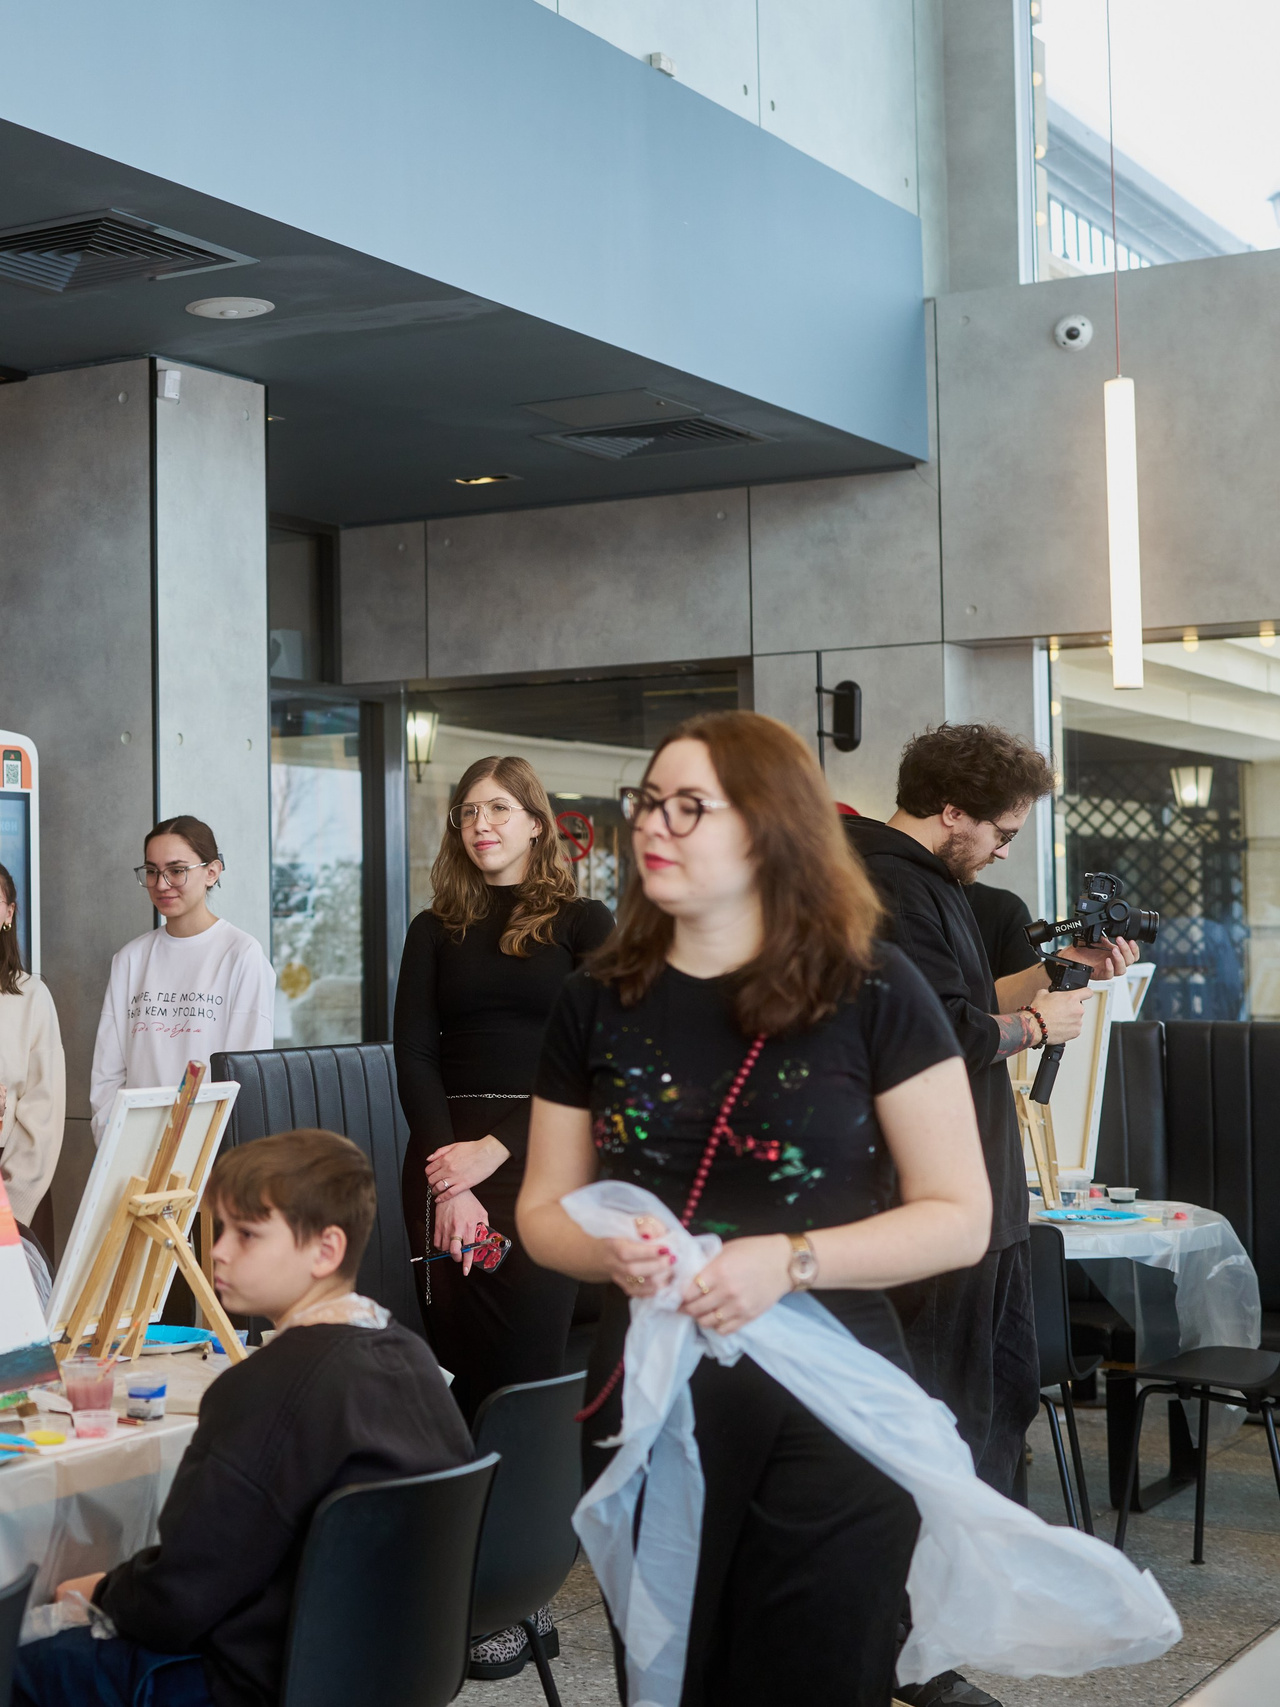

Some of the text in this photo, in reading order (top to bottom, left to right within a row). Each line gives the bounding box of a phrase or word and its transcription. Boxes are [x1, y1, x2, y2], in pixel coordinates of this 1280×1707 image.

[1054, 920, 1082, 933] RONIN
[130, 991, 224, 1006] МРЕ, ГДЕ МОЖНО
[145, 1006, 168, 1017] КЕМ
[172, 1006, 217, 1022] УГОДНО,
